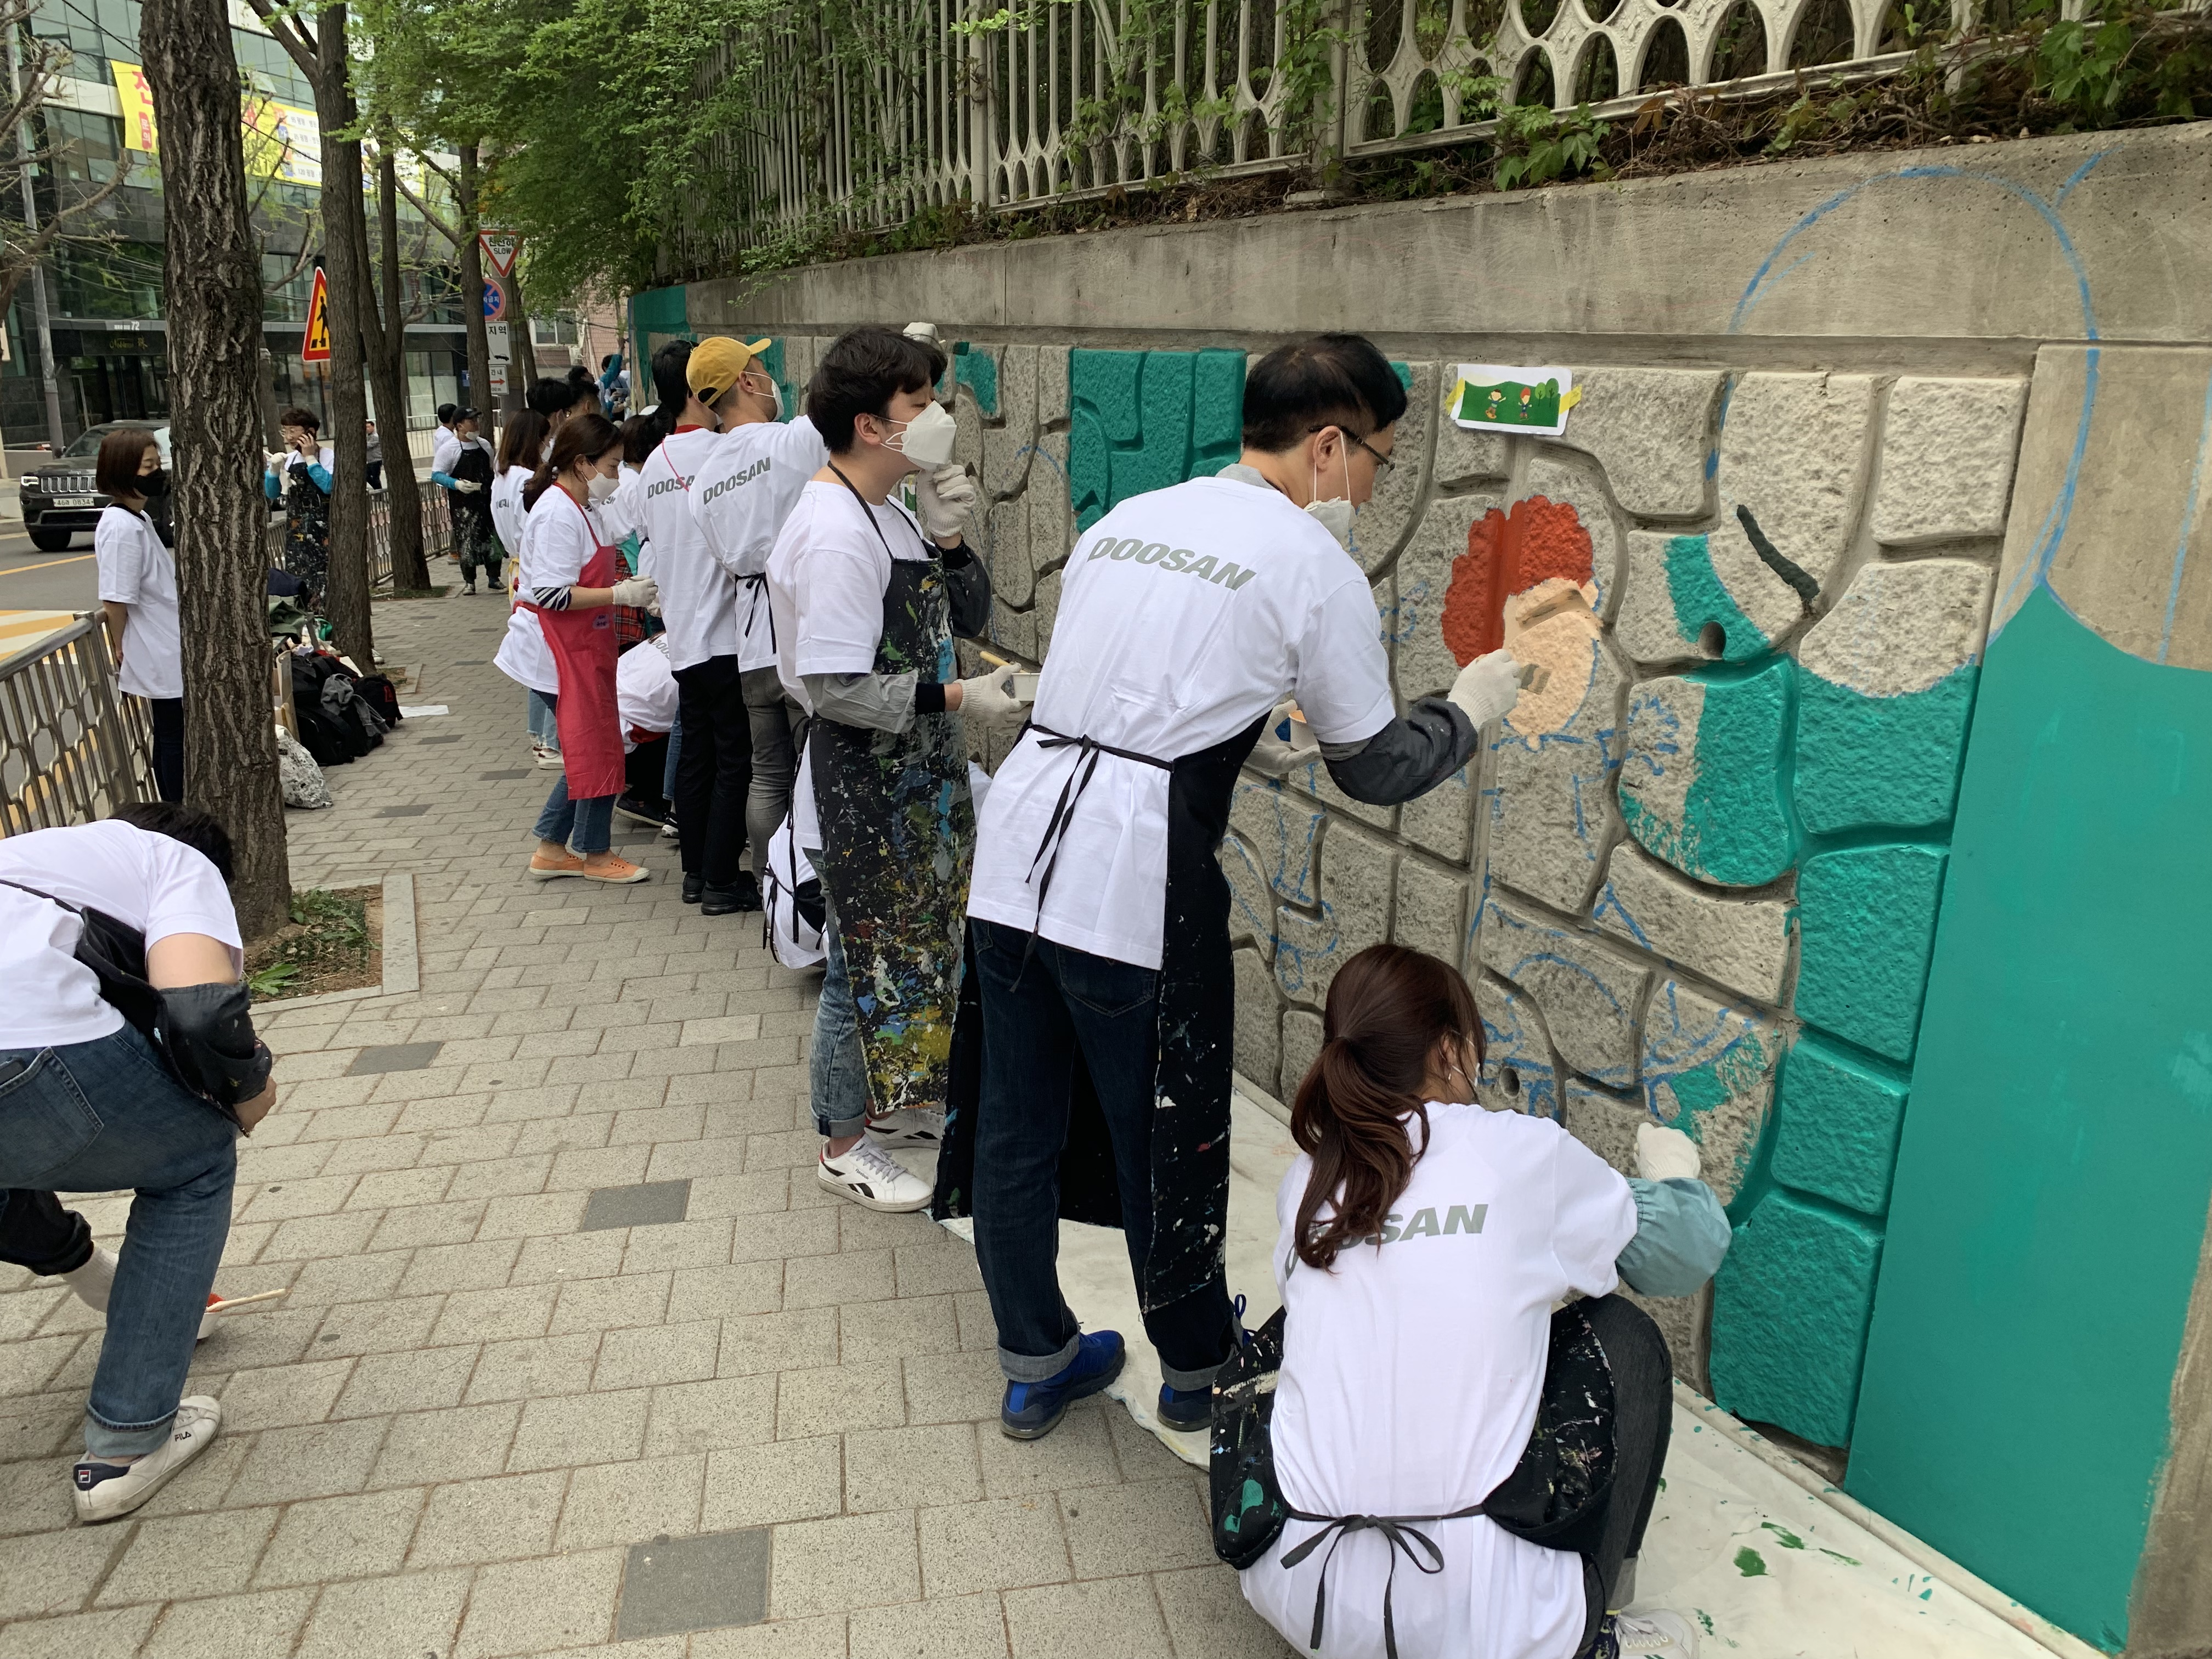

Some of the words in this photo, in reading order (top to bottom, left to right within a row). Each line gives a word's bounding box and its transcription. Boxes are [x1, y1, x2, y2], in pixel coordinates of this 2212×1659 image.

[131, 321, 139, 330] 72
[648, 475, 695, 499] DOOSA
[703, 457, 771, 505] DOOSAN
[1087, 537, 1257, 591] DOOSAN
[174, 1431, 191, 1442] FILA
